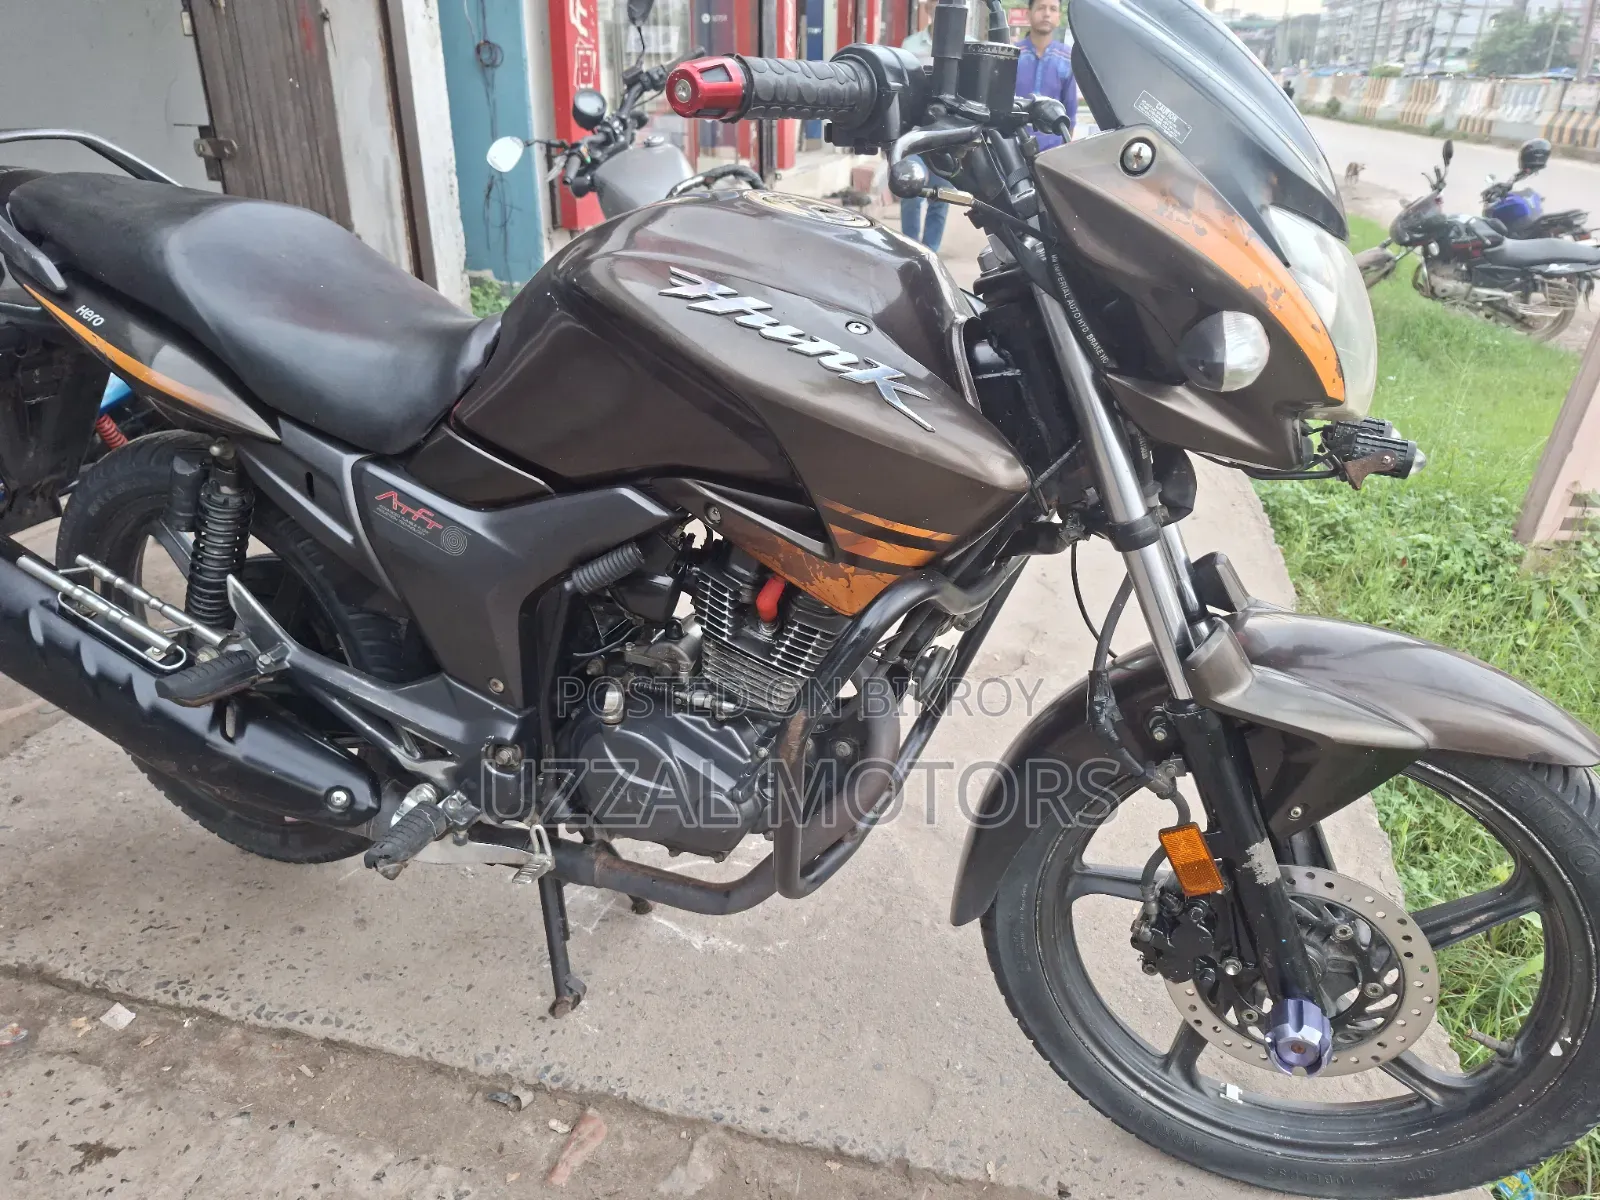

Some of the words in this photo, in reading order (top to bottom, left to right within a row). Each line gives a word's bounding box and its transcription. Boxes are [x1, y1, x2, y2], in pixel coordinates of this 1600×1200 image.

[75, 304, 105, 327] Hero
[1066, 298, 1081, 319] AUTO
[1086, 333, 1104, 356] BRAKE
[658, 266, 936, 432] Hunk
